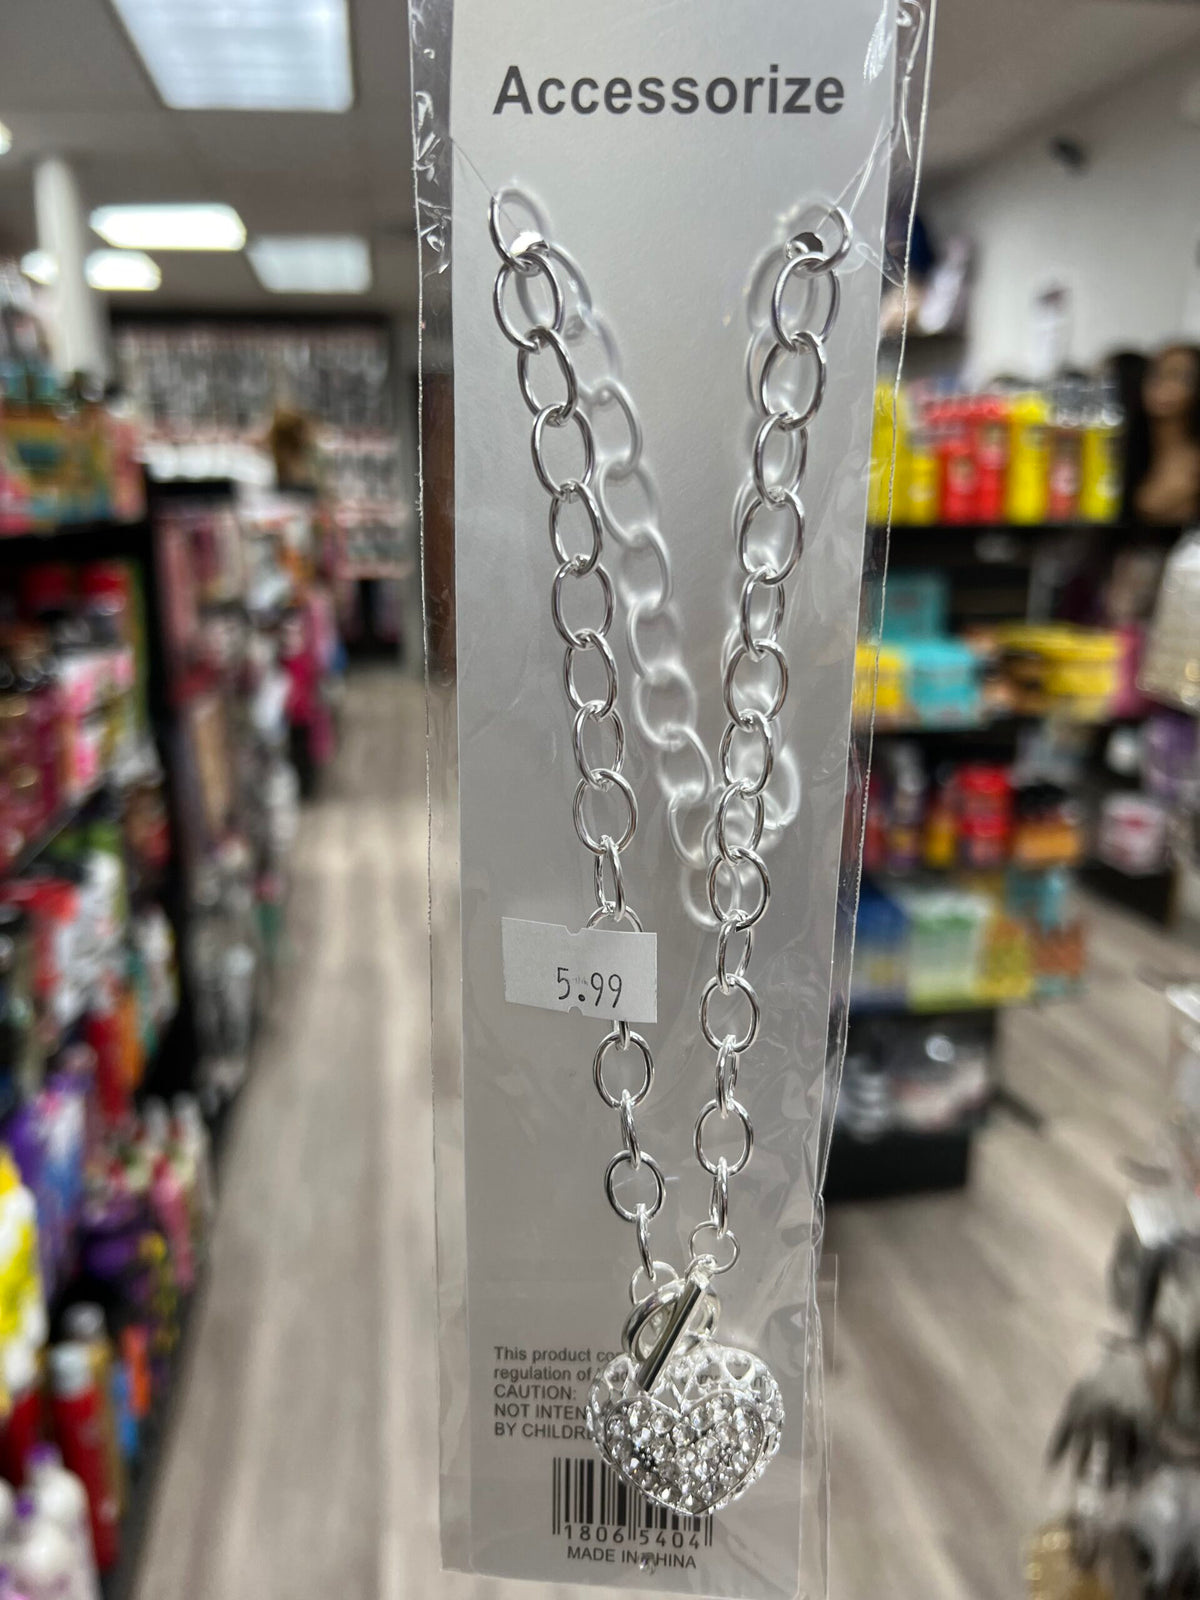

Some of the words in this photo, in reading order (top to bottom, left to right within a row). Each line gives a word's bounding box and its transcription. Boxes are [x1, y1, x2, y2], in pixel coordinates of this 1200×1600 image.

[493, 64, 845, 115] Accessorize
[557, 967, 623, 1008] 5.99
[494, 1346, 527, 1360] This
[532, 1347, 591, 1363] product
[494, 1366, 572, 1382] regulation
[577, 1367, 592, 1381] of
[494, 1384, 577, 1400] CAUTION:
[494, 1403, 530, 1418] NOT
[536, 1404, 587, 1420] INTEN
[494, 1421, 517, 1436] BY
[567, 1545, 616, 1563] MADE
[621, 1549, 638, 1564] IN
[640, 1552, 697, 1569] HINA
